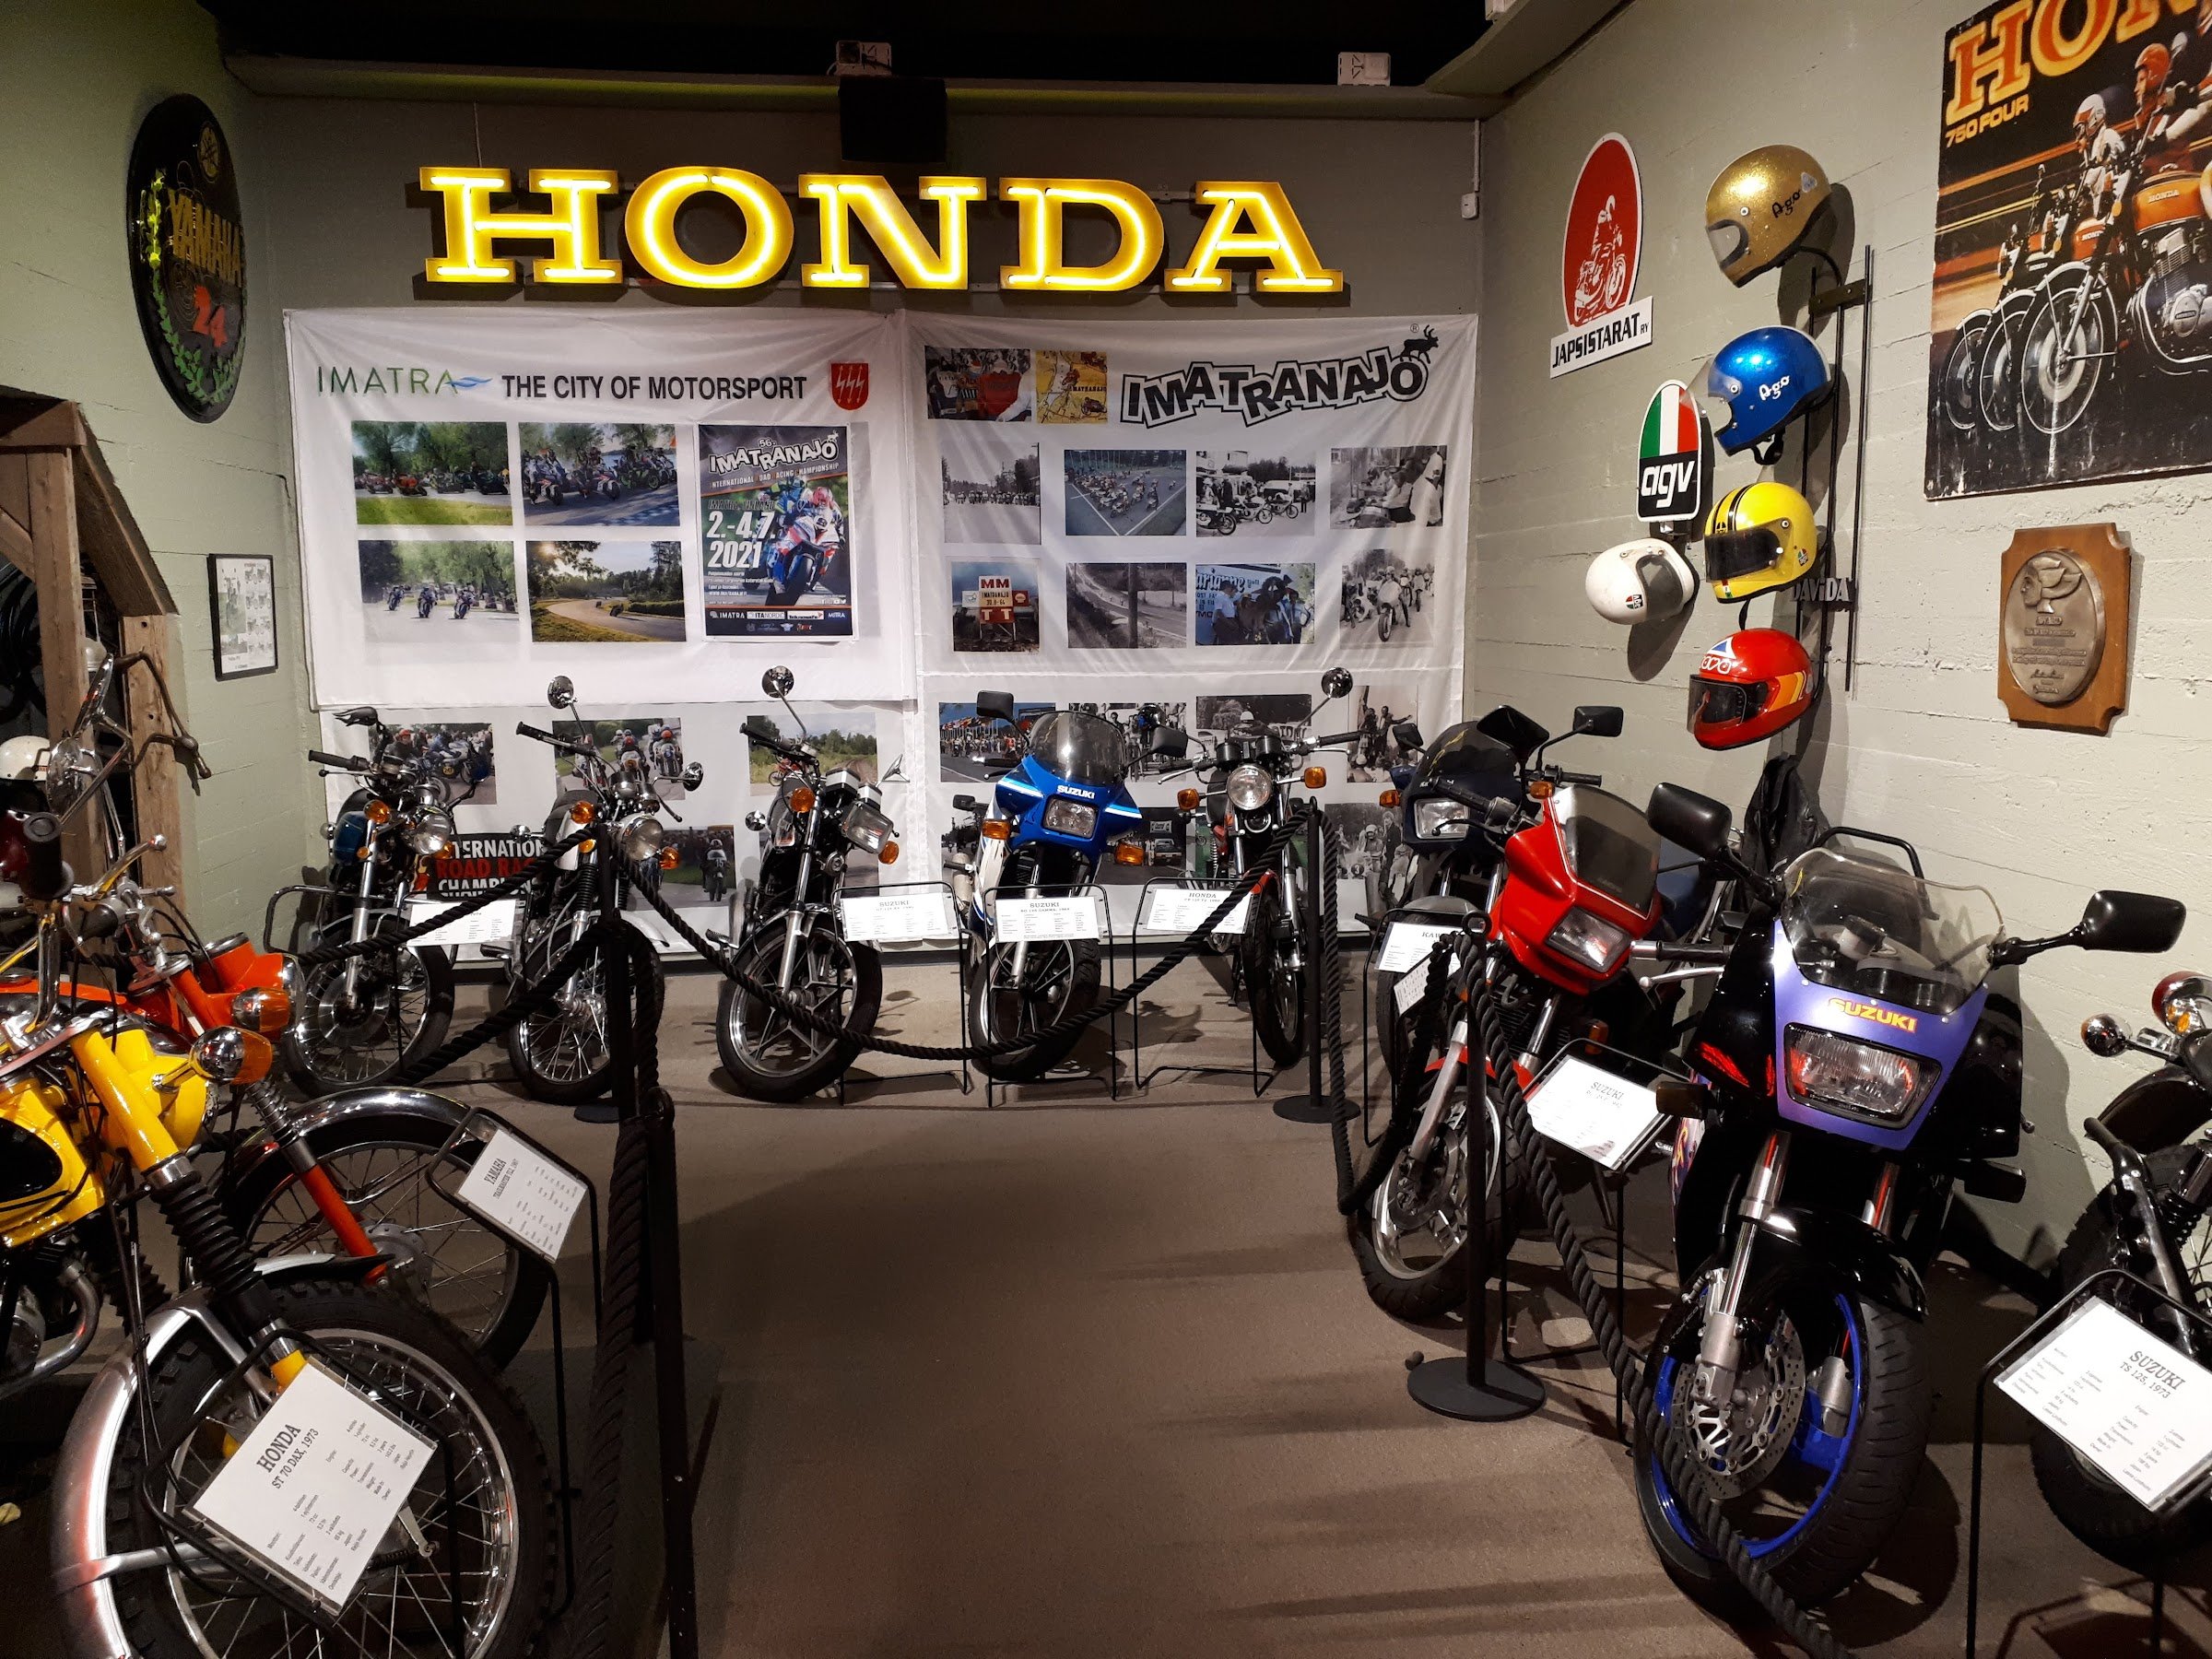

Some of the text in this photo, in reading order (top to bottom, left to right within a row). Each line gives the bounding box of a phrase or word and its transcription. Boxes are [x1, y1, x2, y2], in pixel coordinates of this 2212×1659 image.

[1945, 93, 2029, 148] 750 FOUR
[1771, 189, 1802, 218] Ago
[2147, 189, 2179, 204] HONDA
[166, 187, 242, 288] YAMAHA
[420, 169, 1343, 293] HONDA
[193, 284, 227, 348] 24
[1552, 312, 1649, 369] JAPSISTARAT RY
[318, 366, 459, 395] IMATRA
[501, 374, 807, 400] THE CITY OF MOTORSPORT
[1120, 346, 1428, 428] IMATRANAJO
[1759, 375, 1790, 400] Ago
[709, 440, 839, 475] IMATRANAJO
[759, 438, 776, 448] 56.
[1641, 461, 1695, 509] agv
[708, 541, 762, 568] 2021
[1056, 784, 1095, 799] SUZUKI
[435, 858, 491, 878] ROAD
[1354, 865, 1360, 875] 3
[1828, 997, 1918, 1033] SUZUKI
[1591, 1081, 1625, 1100] SUZUKI
[483, 1158, 507, 1185] YAMAHA
[2120, 1361, 2171, 1399] TS 125, 1973
[2129, 1350, 2185, 1391] SUZUKI
[256, 1423, 301, 1473] HONDA
[271, 1428, 319, 1489] ST 70 DAX, 1973
